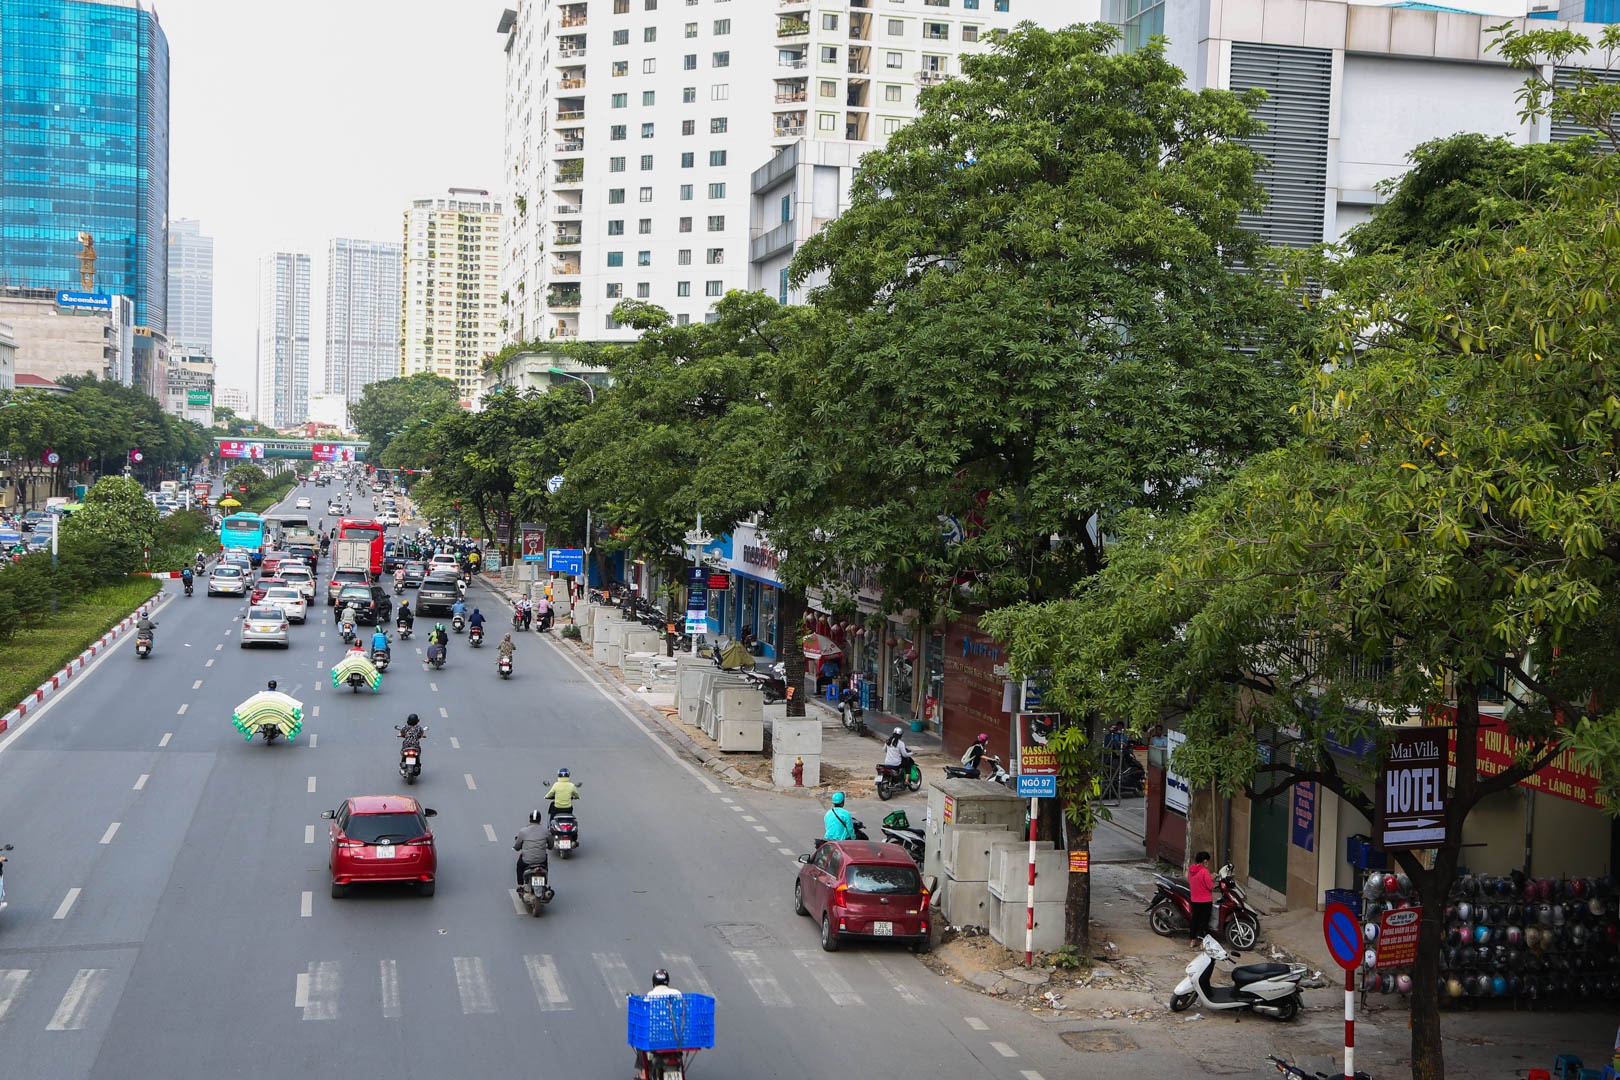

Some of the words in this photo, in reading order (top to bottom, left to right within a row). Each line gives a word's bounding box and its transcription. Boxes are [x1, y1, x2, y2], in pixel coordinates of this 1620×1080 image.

[62, 294, 108, 304] Sacombank
[1391, 743, 1412, 758] Mai
[1414, 741, 1439, 757] Villa
[1485, 730, 1501, 753] KHU
[1022, 756, 1057, 766] GEISHA
[1021, 777, 1040, 787] NGÕ
[1386, 768, 1443, 813] HOTEL
[1549, 778, 1571, 796] LÁNG
[1574, 785, 1587, 802] HẠ
